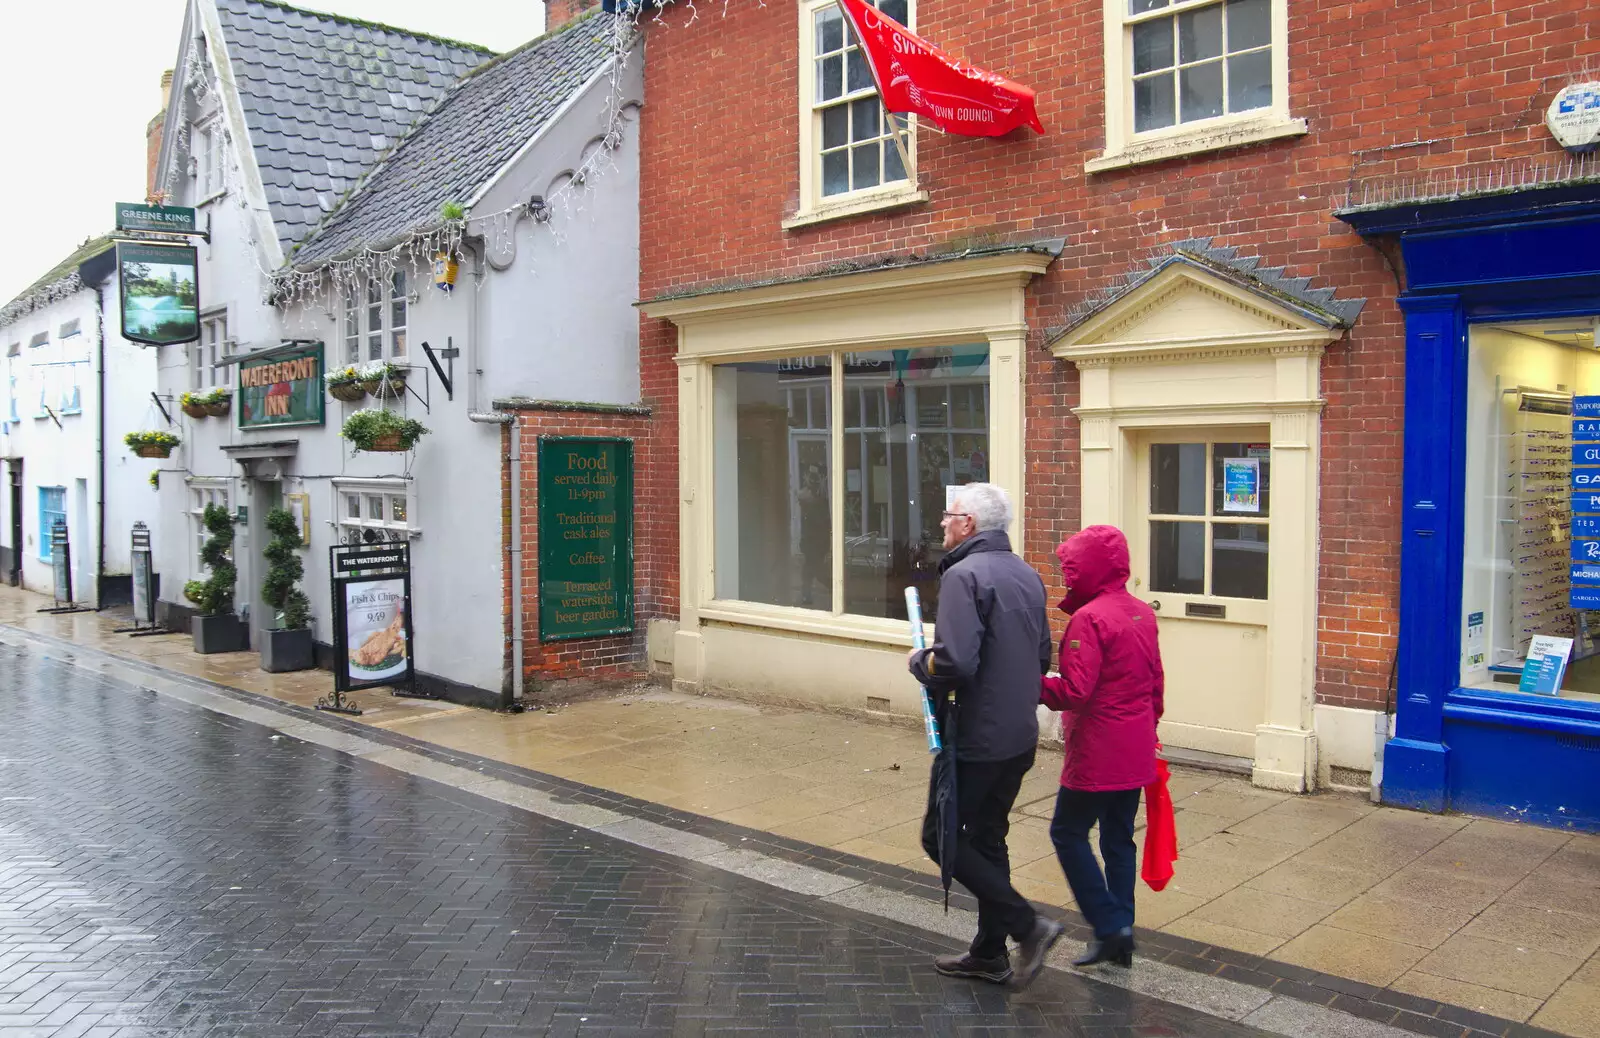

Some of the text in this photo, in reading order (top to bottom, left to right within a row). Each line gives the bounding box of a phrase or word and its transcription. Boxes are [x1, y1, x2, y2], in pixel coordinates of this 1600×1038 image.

[957, 107, 995, 124] COUNCIL
[121, 209, 191, 223] GREENE KING
[240, 357, 316, 387] WATERFRONT
[264, 395, 290, 416] INN
[567, 452, 607, 470] Food
[554, 471, 618, 487] served daily
[568, 488, 606, 502] 11-9pm
[556, 511, 616, 525] Traditional
[563, 525, 611, 540] cask ales
[342, 555, 399, 566] THE WATERFRONT
[569, 552, 606, 566] Coffee
[563, 578, 611, 593] Terraced
[351, 591, 400, 604] Fish & Chips
[560, 592, 614, 609] waterside
[367, 612, 386, 623] 9.49
[555, 608, 619, 624] beer garden
